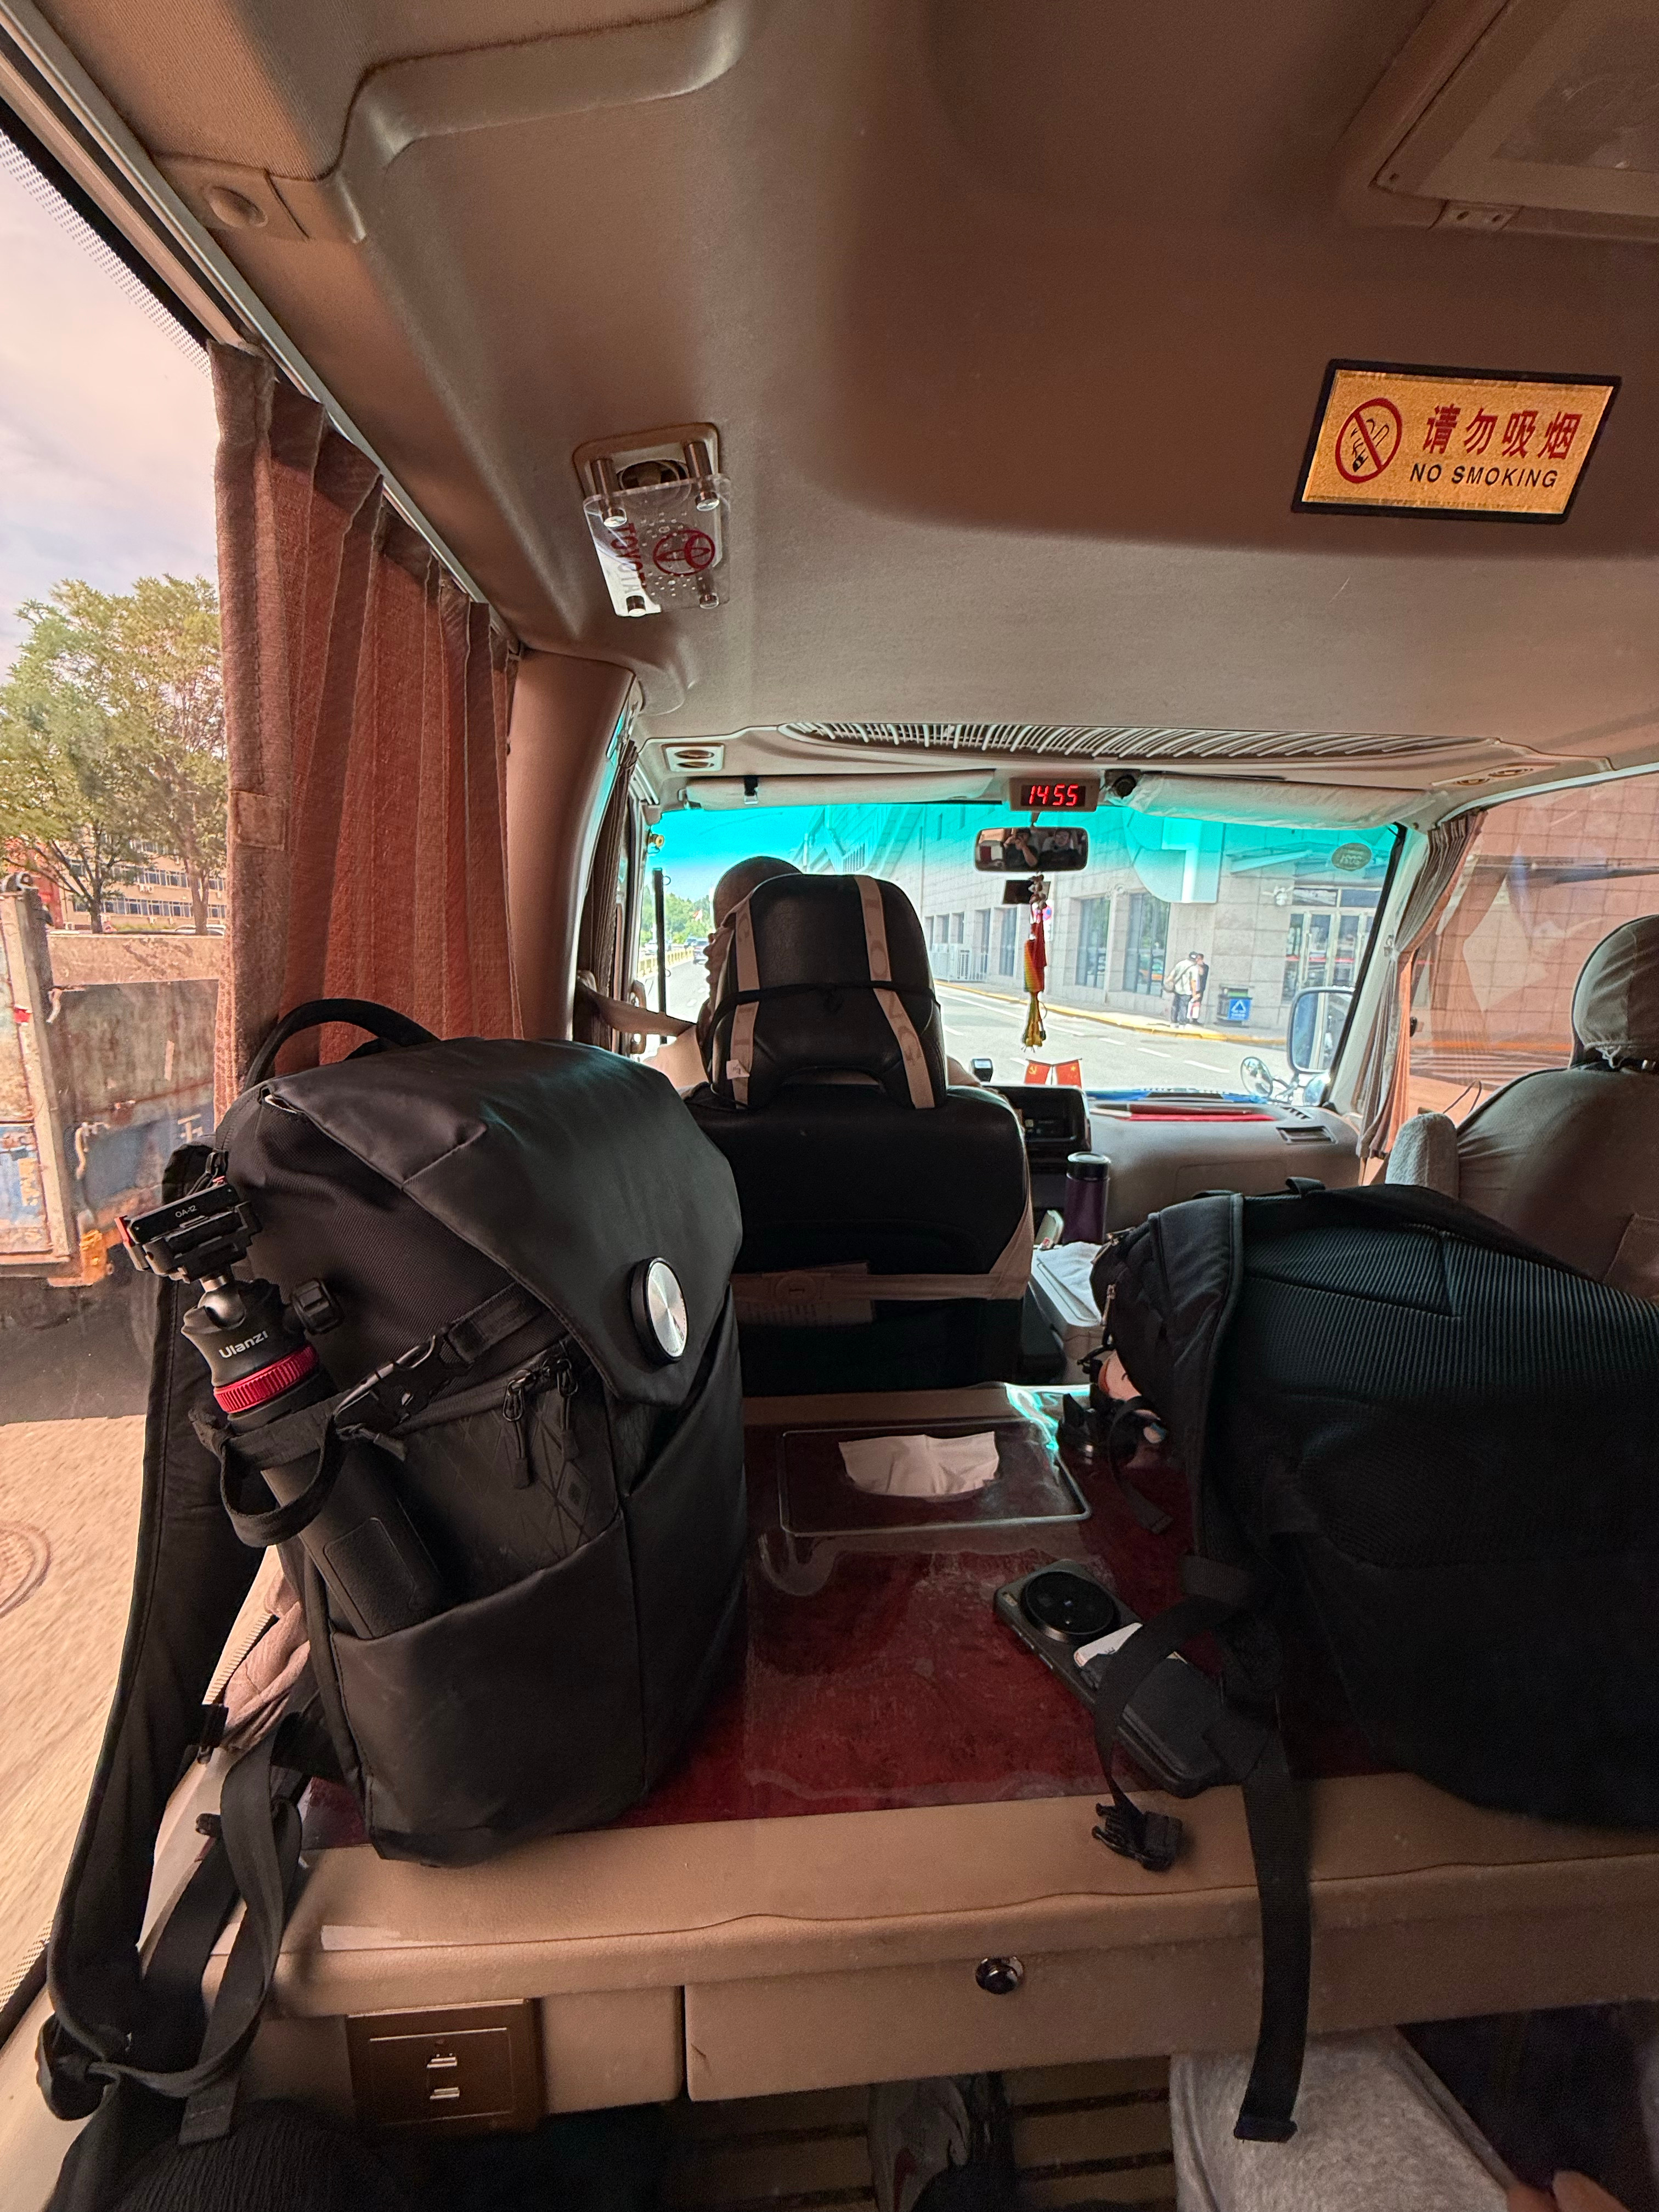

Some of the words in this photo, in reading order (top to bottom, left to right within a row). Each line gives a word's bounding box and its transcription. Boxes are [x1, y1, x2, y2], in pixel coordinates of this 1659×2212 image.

[1423, 404, 1582, 460] 请勿吸烟
[1409, 463, 1442, 482] NO
[1452, 466, 1558, 488] SMOKING
[175, 1205, 197, 1217] OA-12
